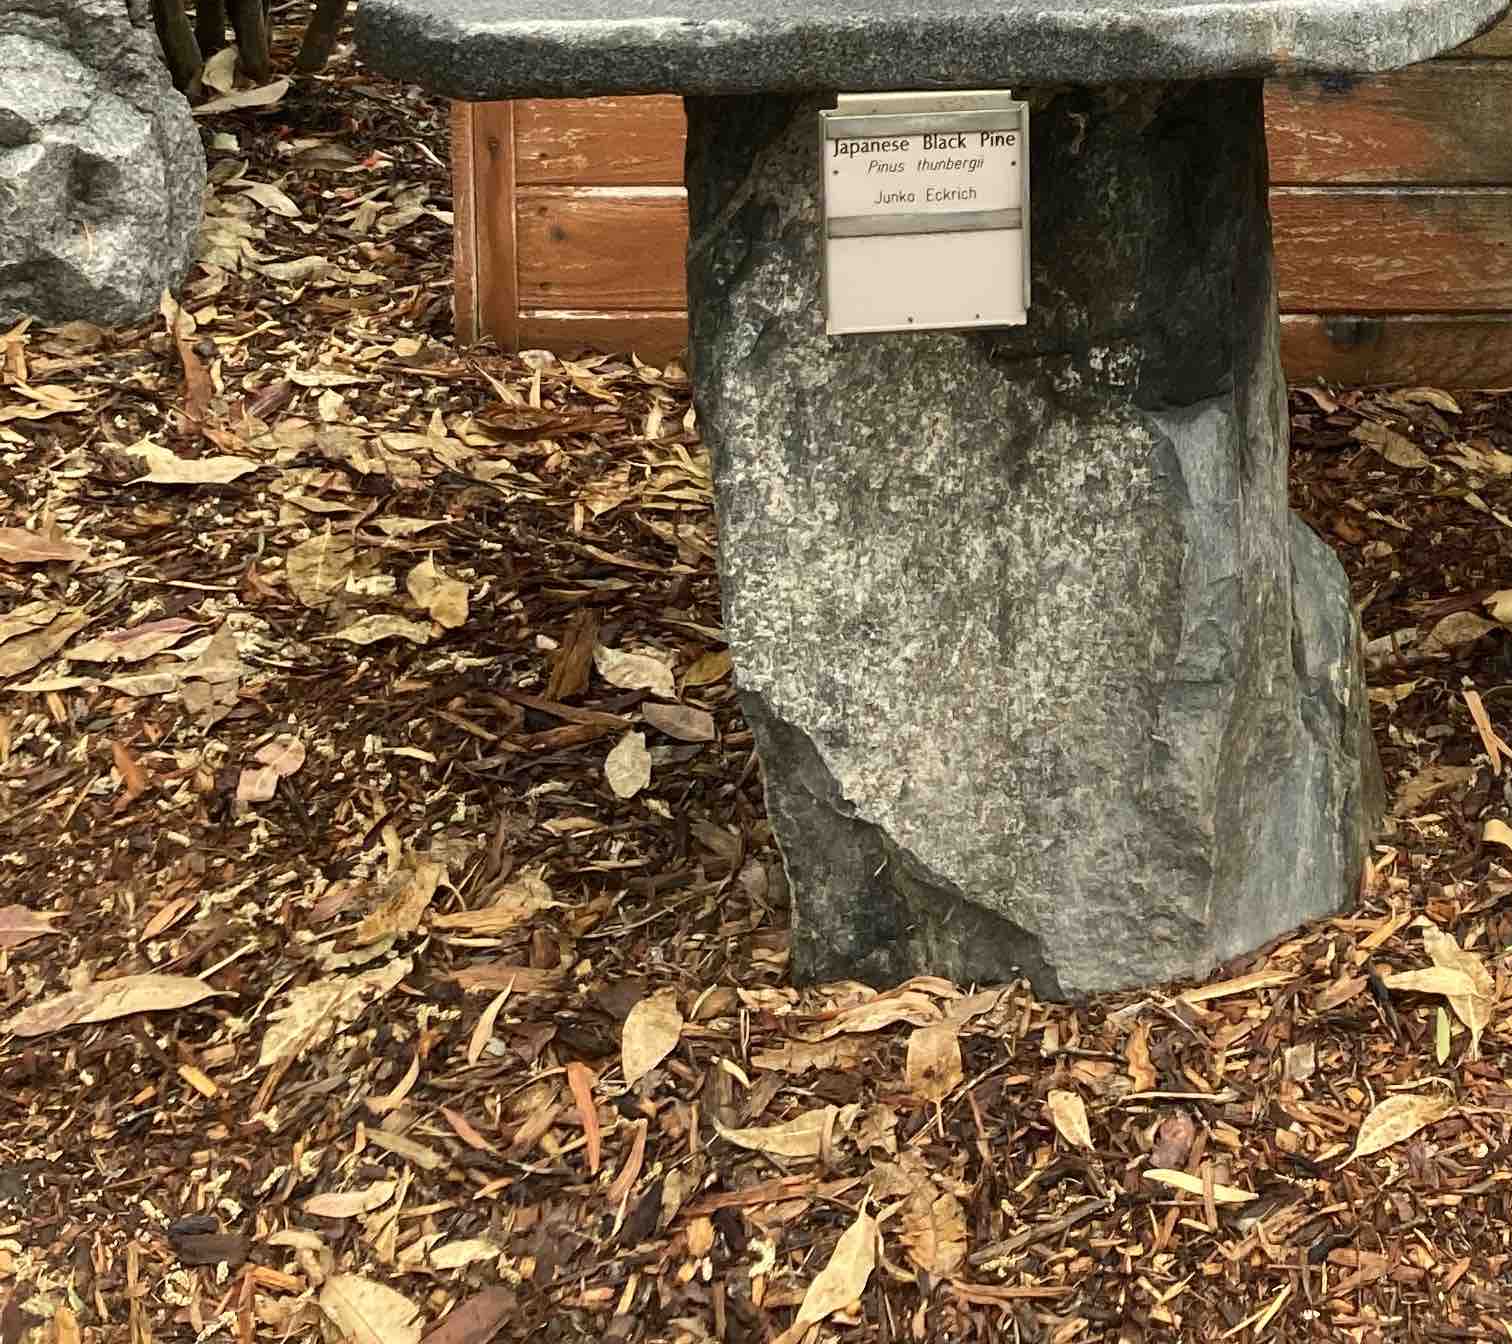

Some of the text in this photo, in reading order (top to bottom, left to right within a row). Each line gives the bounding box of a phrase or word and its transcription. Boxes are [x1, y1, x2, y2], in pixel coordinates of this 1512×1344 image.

[833, 132, 1016, 158] Japanese Black Pine
[868, 159, 905, 174] Pinus
[875, 187, 977, 204] Junko Eckrich
